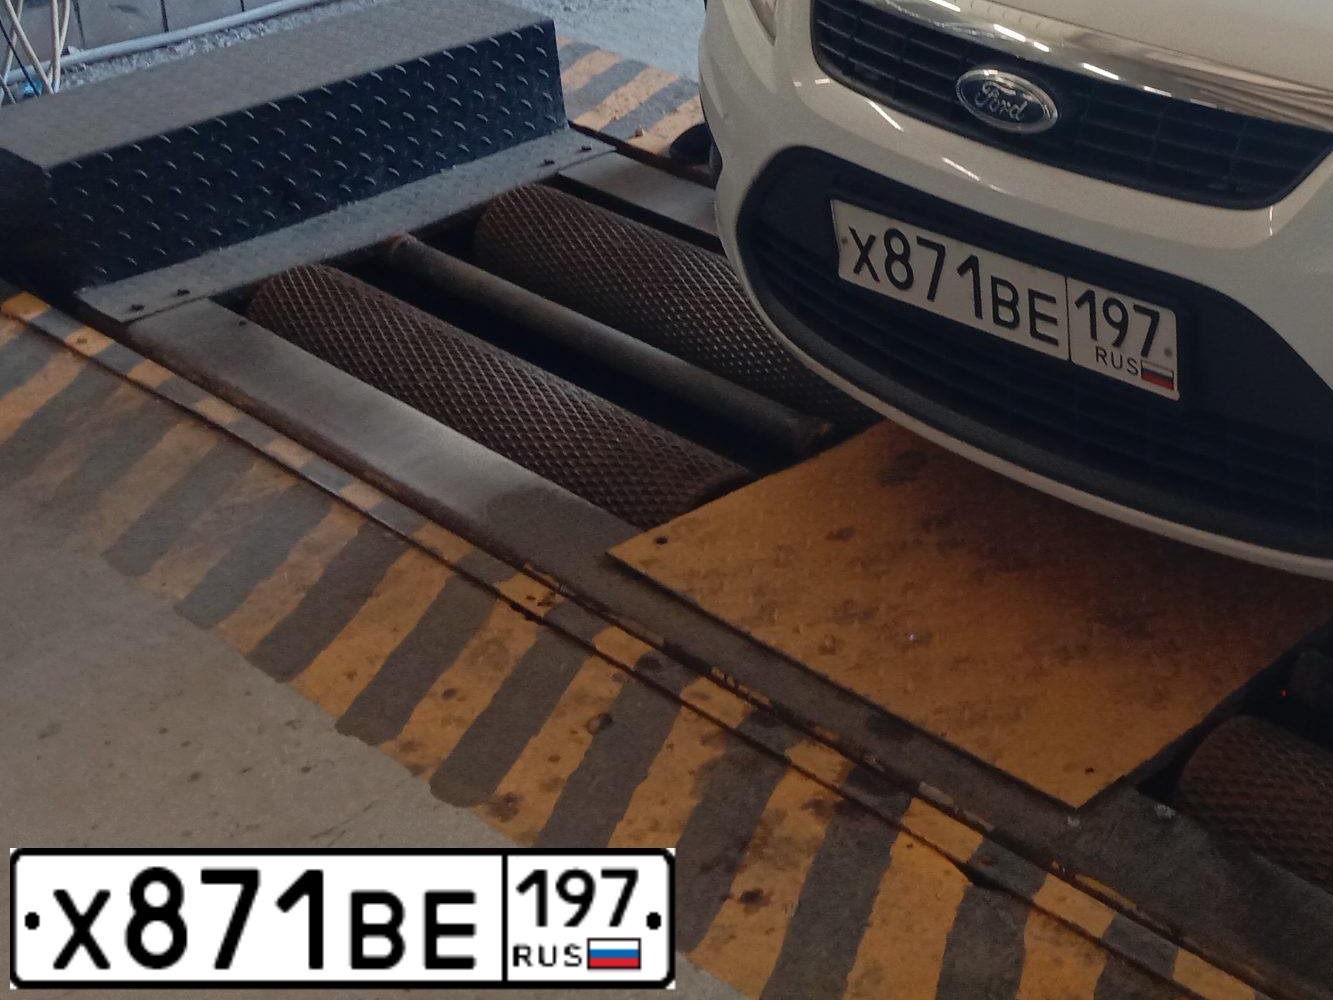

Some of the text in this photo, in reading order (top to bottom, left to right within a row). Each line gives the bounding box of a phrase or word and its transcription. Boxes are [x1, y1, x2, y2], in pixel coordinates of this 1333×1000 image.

[975, 81, 1028, 121] Ford
[1074, 288, 1160, 357] 197
[1095, 346, 1139, 377] RUS
